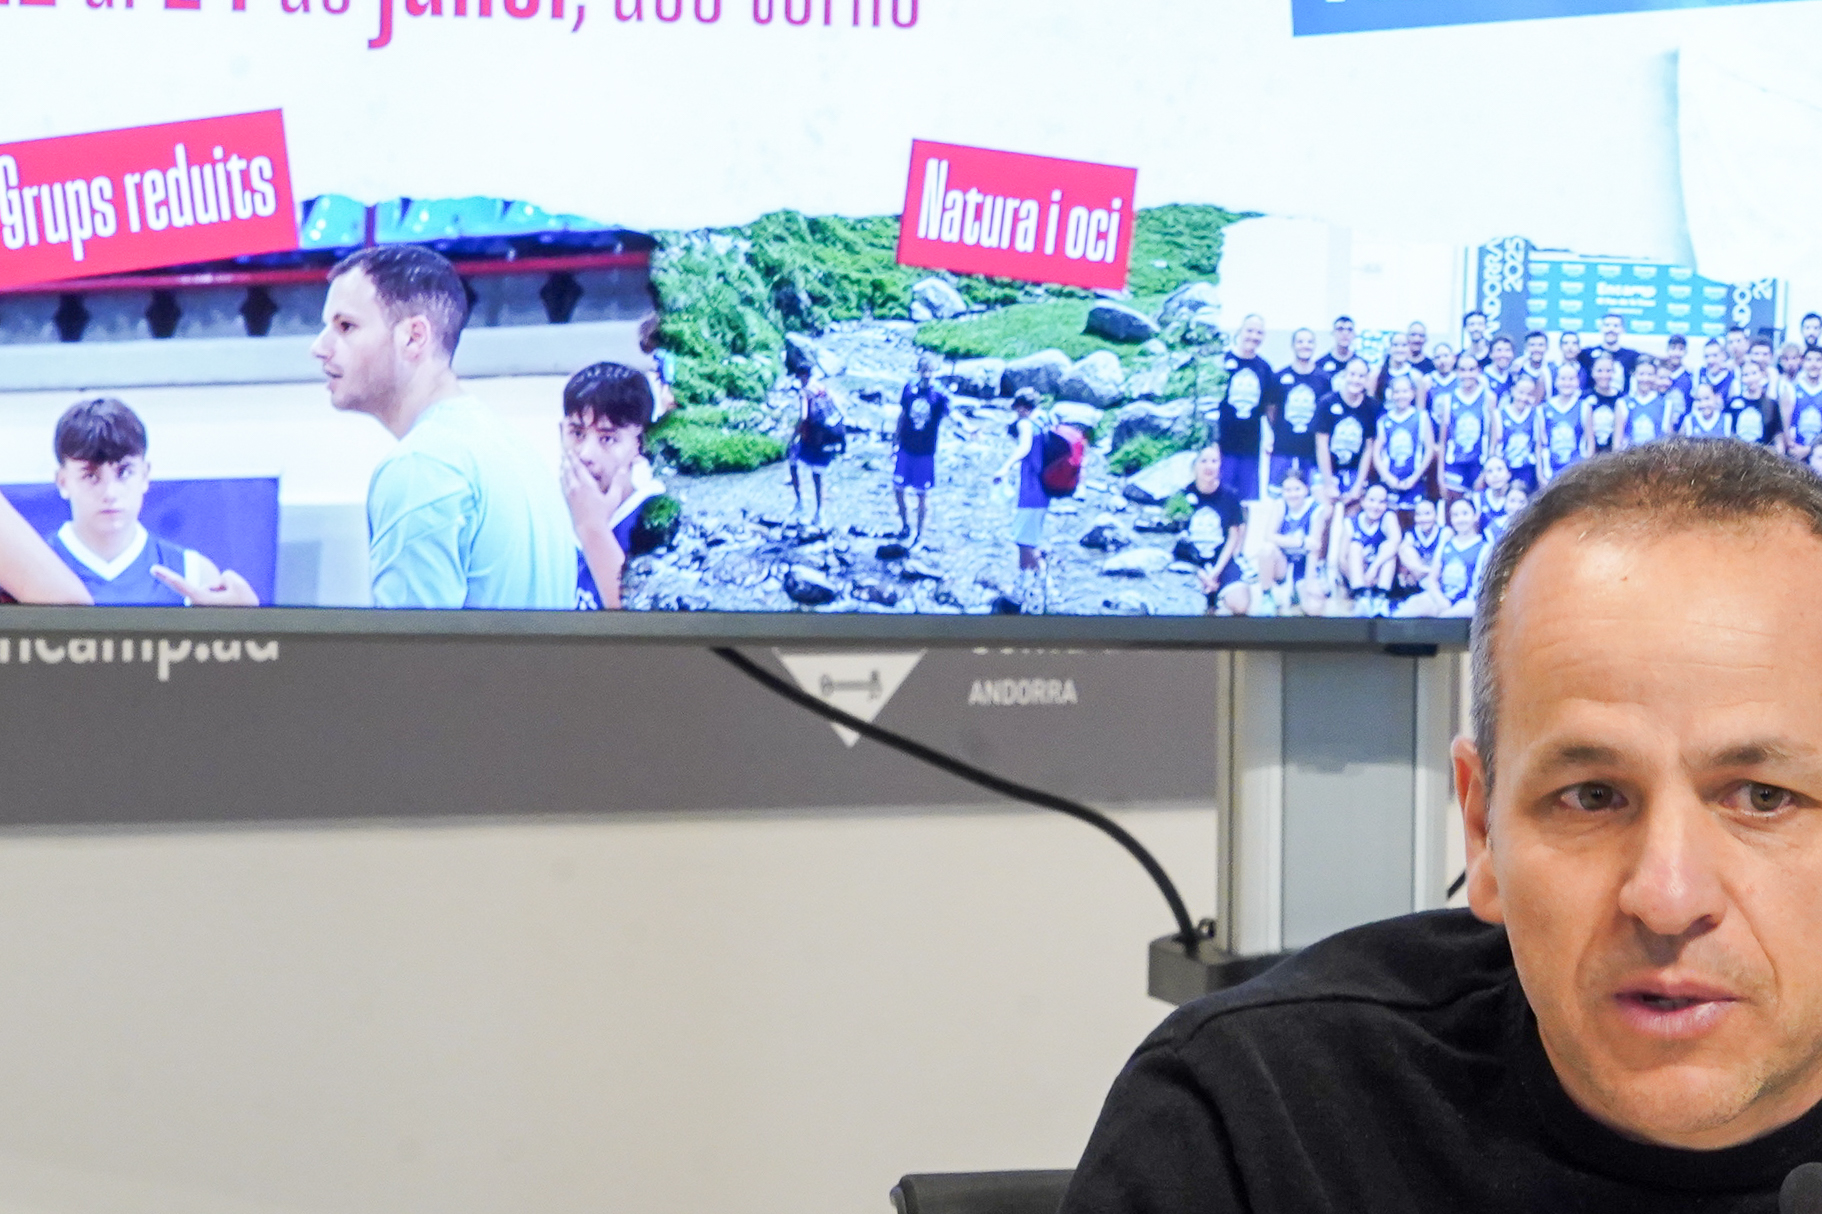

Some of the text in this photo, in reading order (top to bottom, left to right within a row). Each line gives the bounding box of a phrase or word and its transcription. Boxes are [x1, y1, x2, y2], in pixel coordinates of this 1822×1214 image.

[0, 142, 278, 262] Grups reduits
[916, 156, 1123, 265] Natura i oci
[1503, 236, 1525, 293] 2025
[967, 677, 1079, 706] ANDORRA
